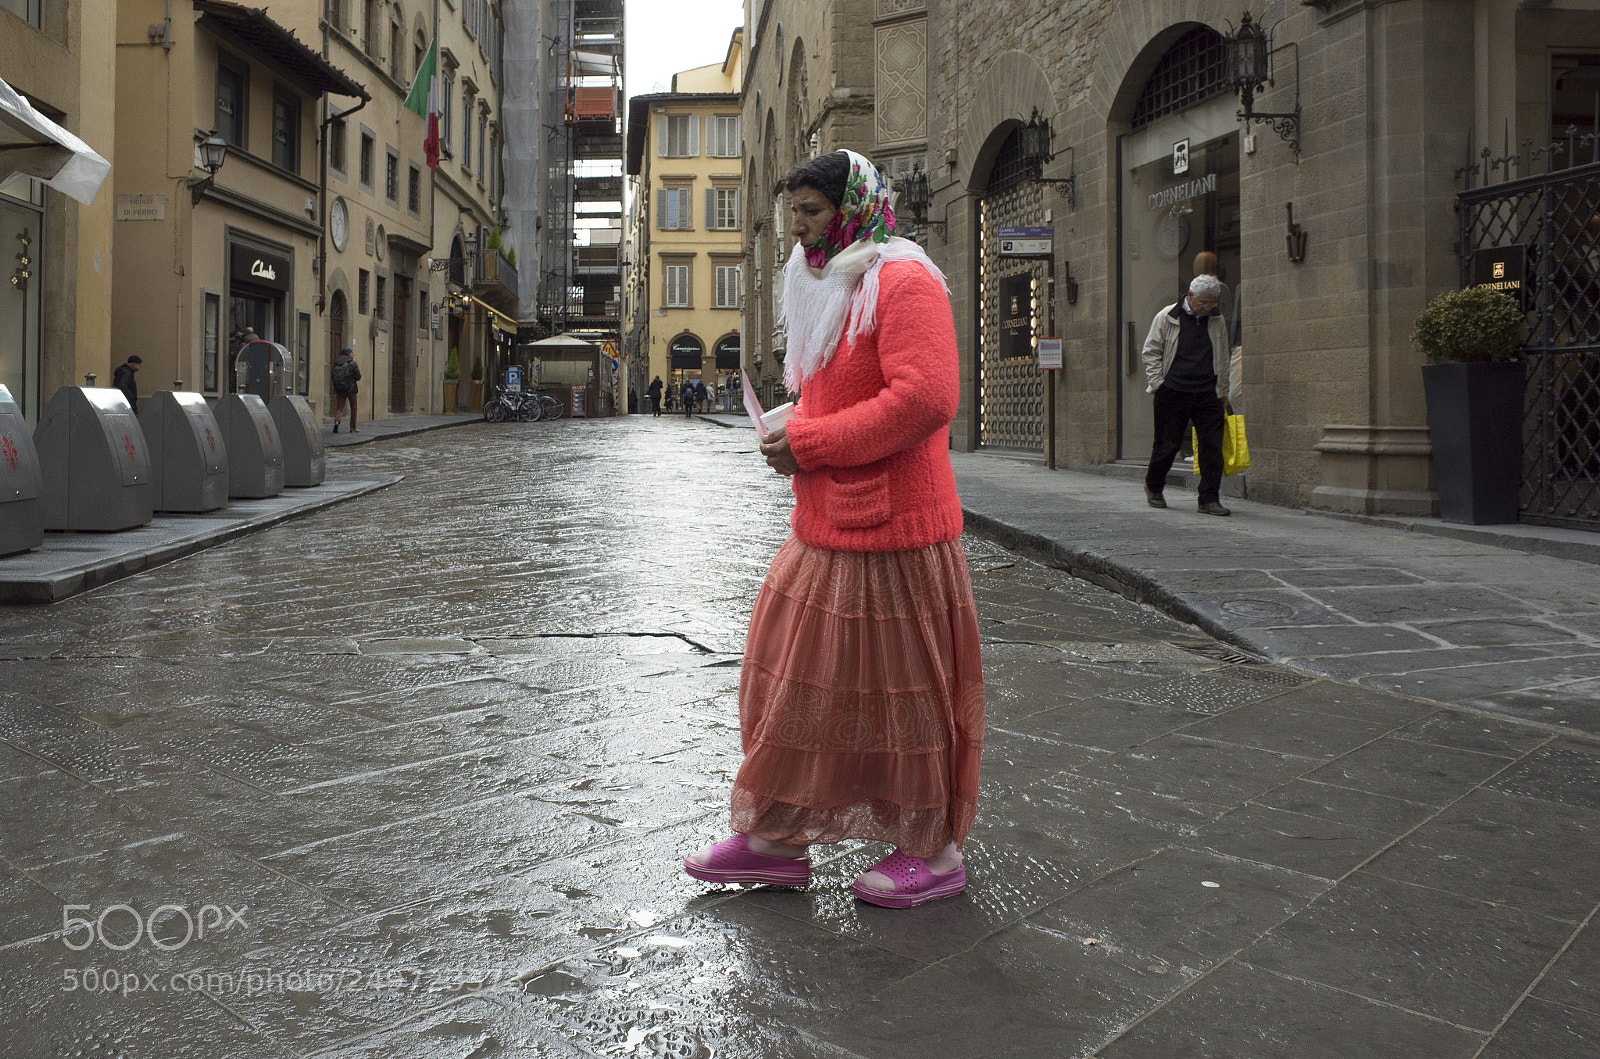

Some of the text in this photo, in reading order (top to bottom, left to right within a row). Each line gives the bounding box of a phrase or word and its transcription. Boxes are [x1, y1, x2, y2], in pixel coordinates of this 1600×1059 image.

[1147, 173, 1217, 210] CORNELIANI
[251, 259, 276, 280] Clarks
[508, 372, 518, 384] P
